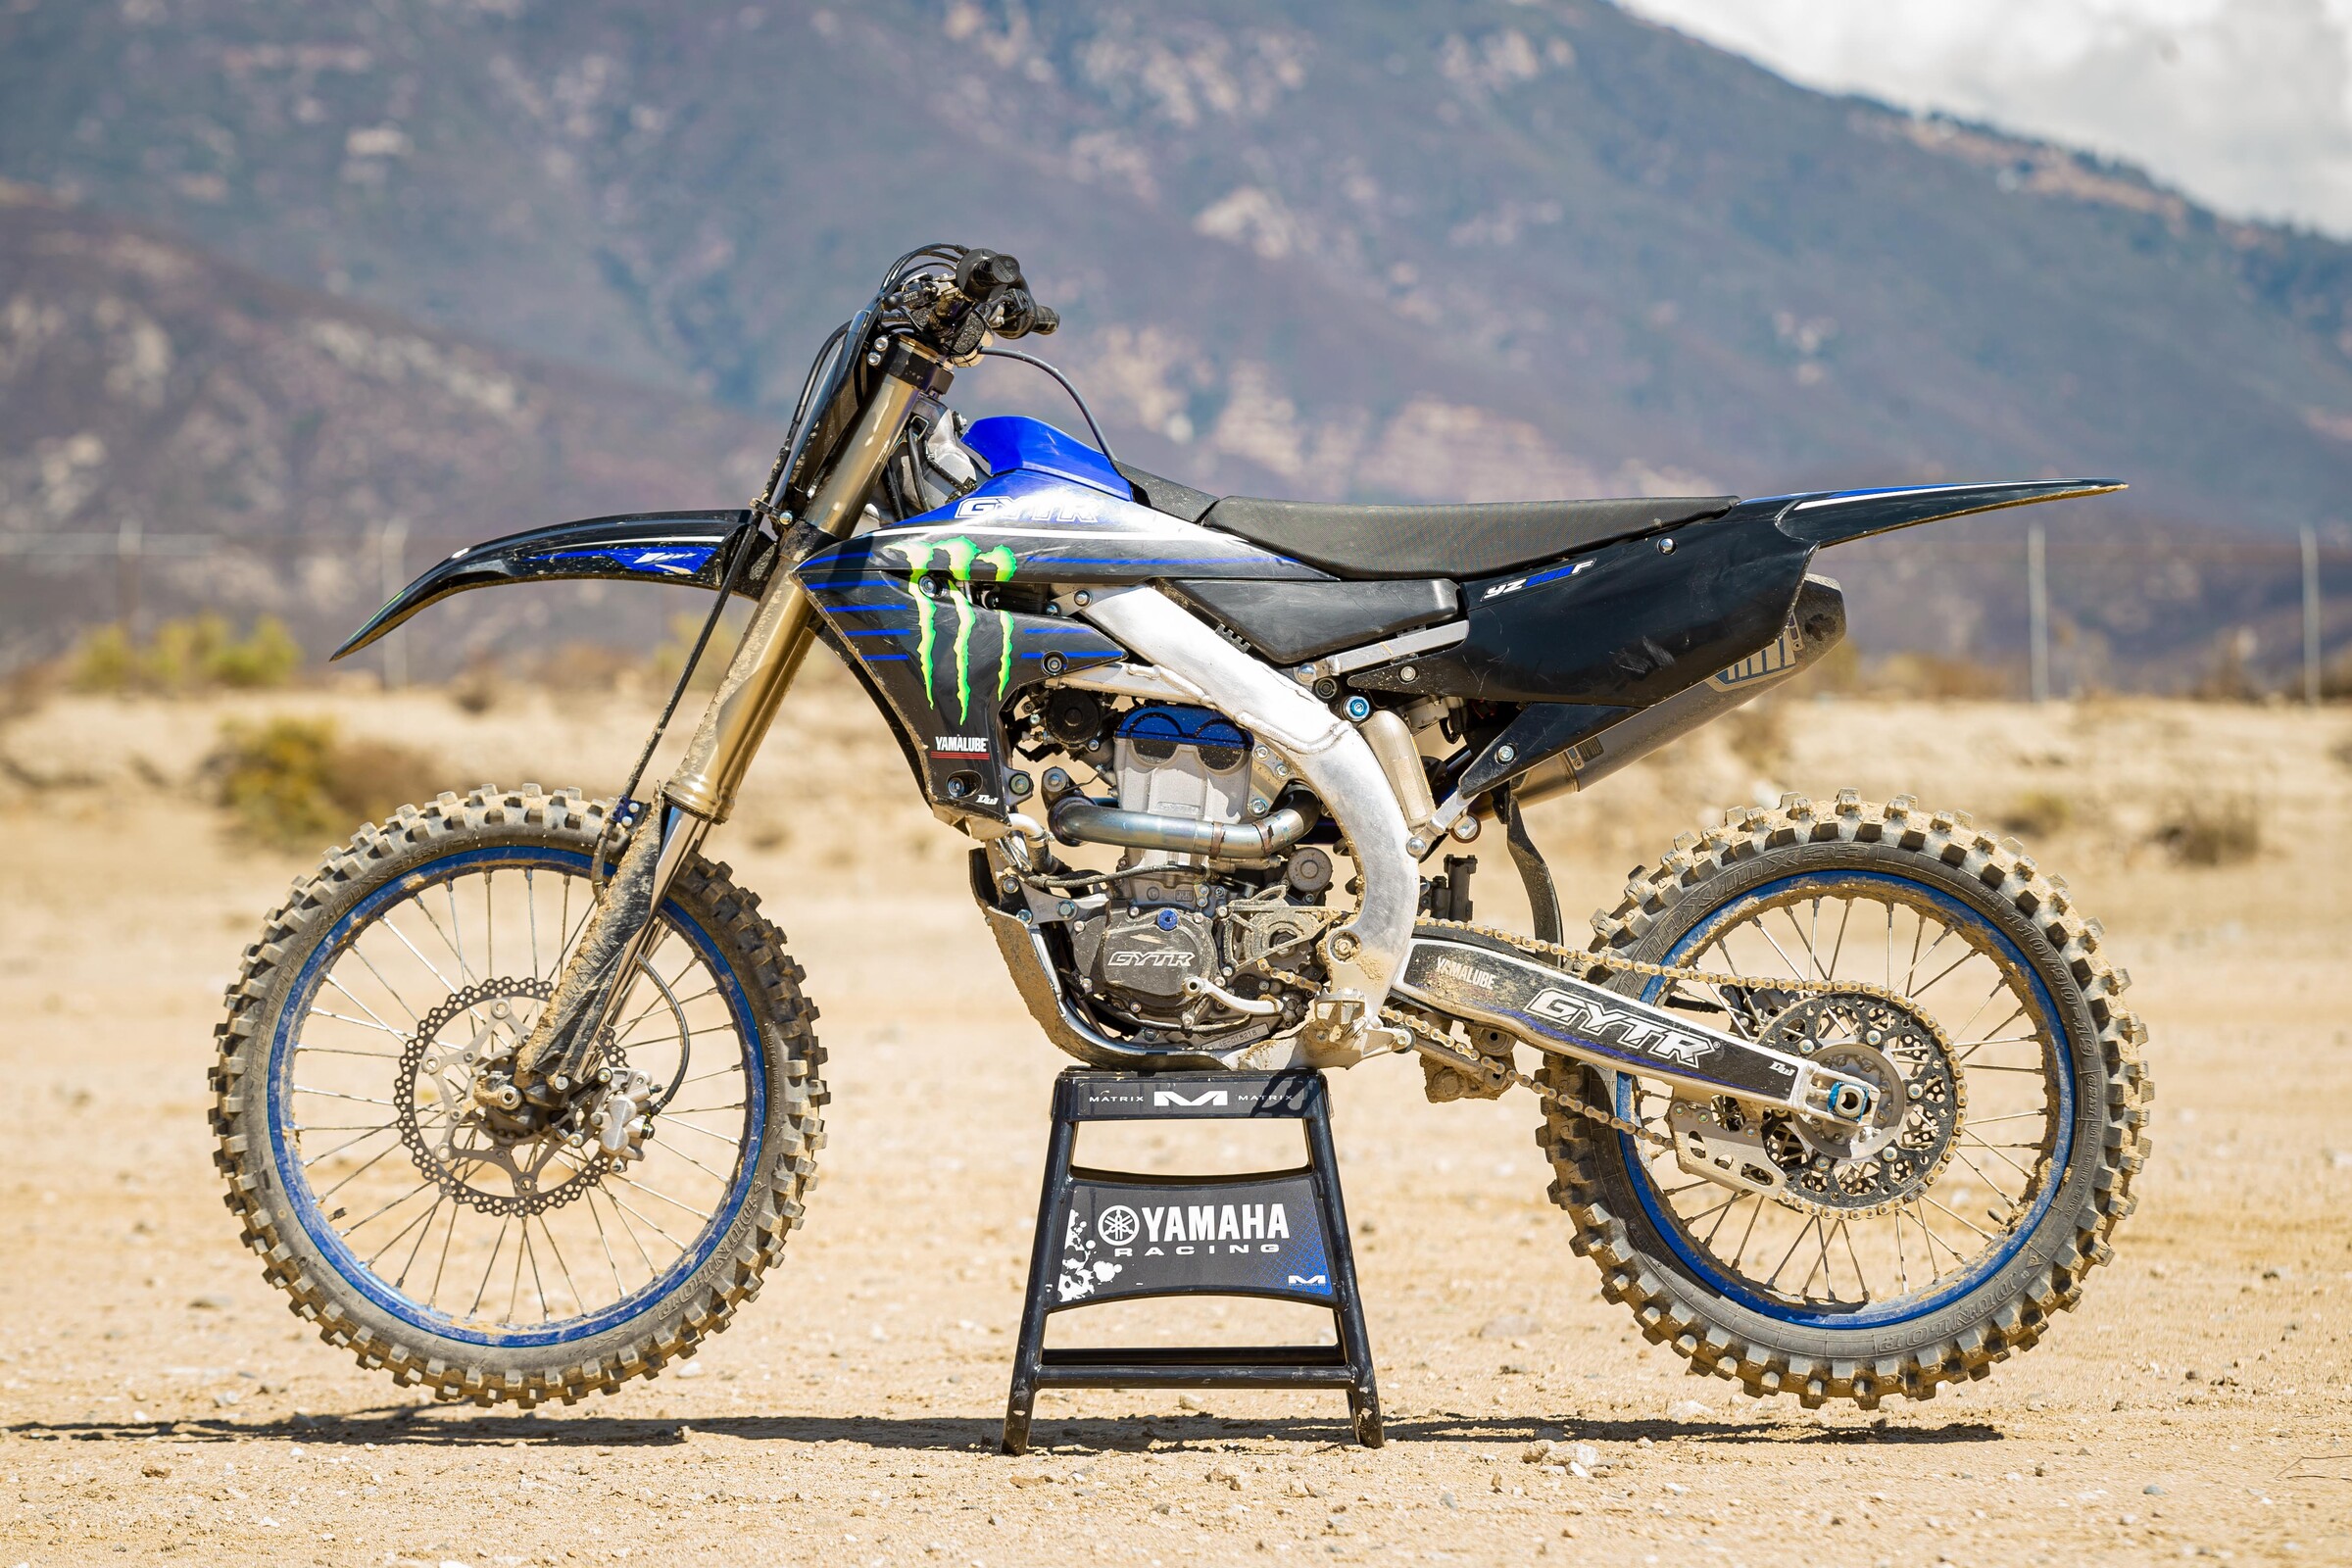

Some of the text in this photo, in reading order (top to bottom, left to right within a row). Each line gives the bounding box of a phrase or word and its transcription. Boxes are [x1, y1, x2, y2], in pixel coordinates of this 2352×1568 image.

[935, 736, 988, 753] YAMALUBE
[1106, 951, 1196, 967] GYTR
[1523, 987, 1715, 1069] GYTR
[1141, 1202, 1290, 1243] YAMAHA
[1113, 1244, 1280, 1257] RACING
